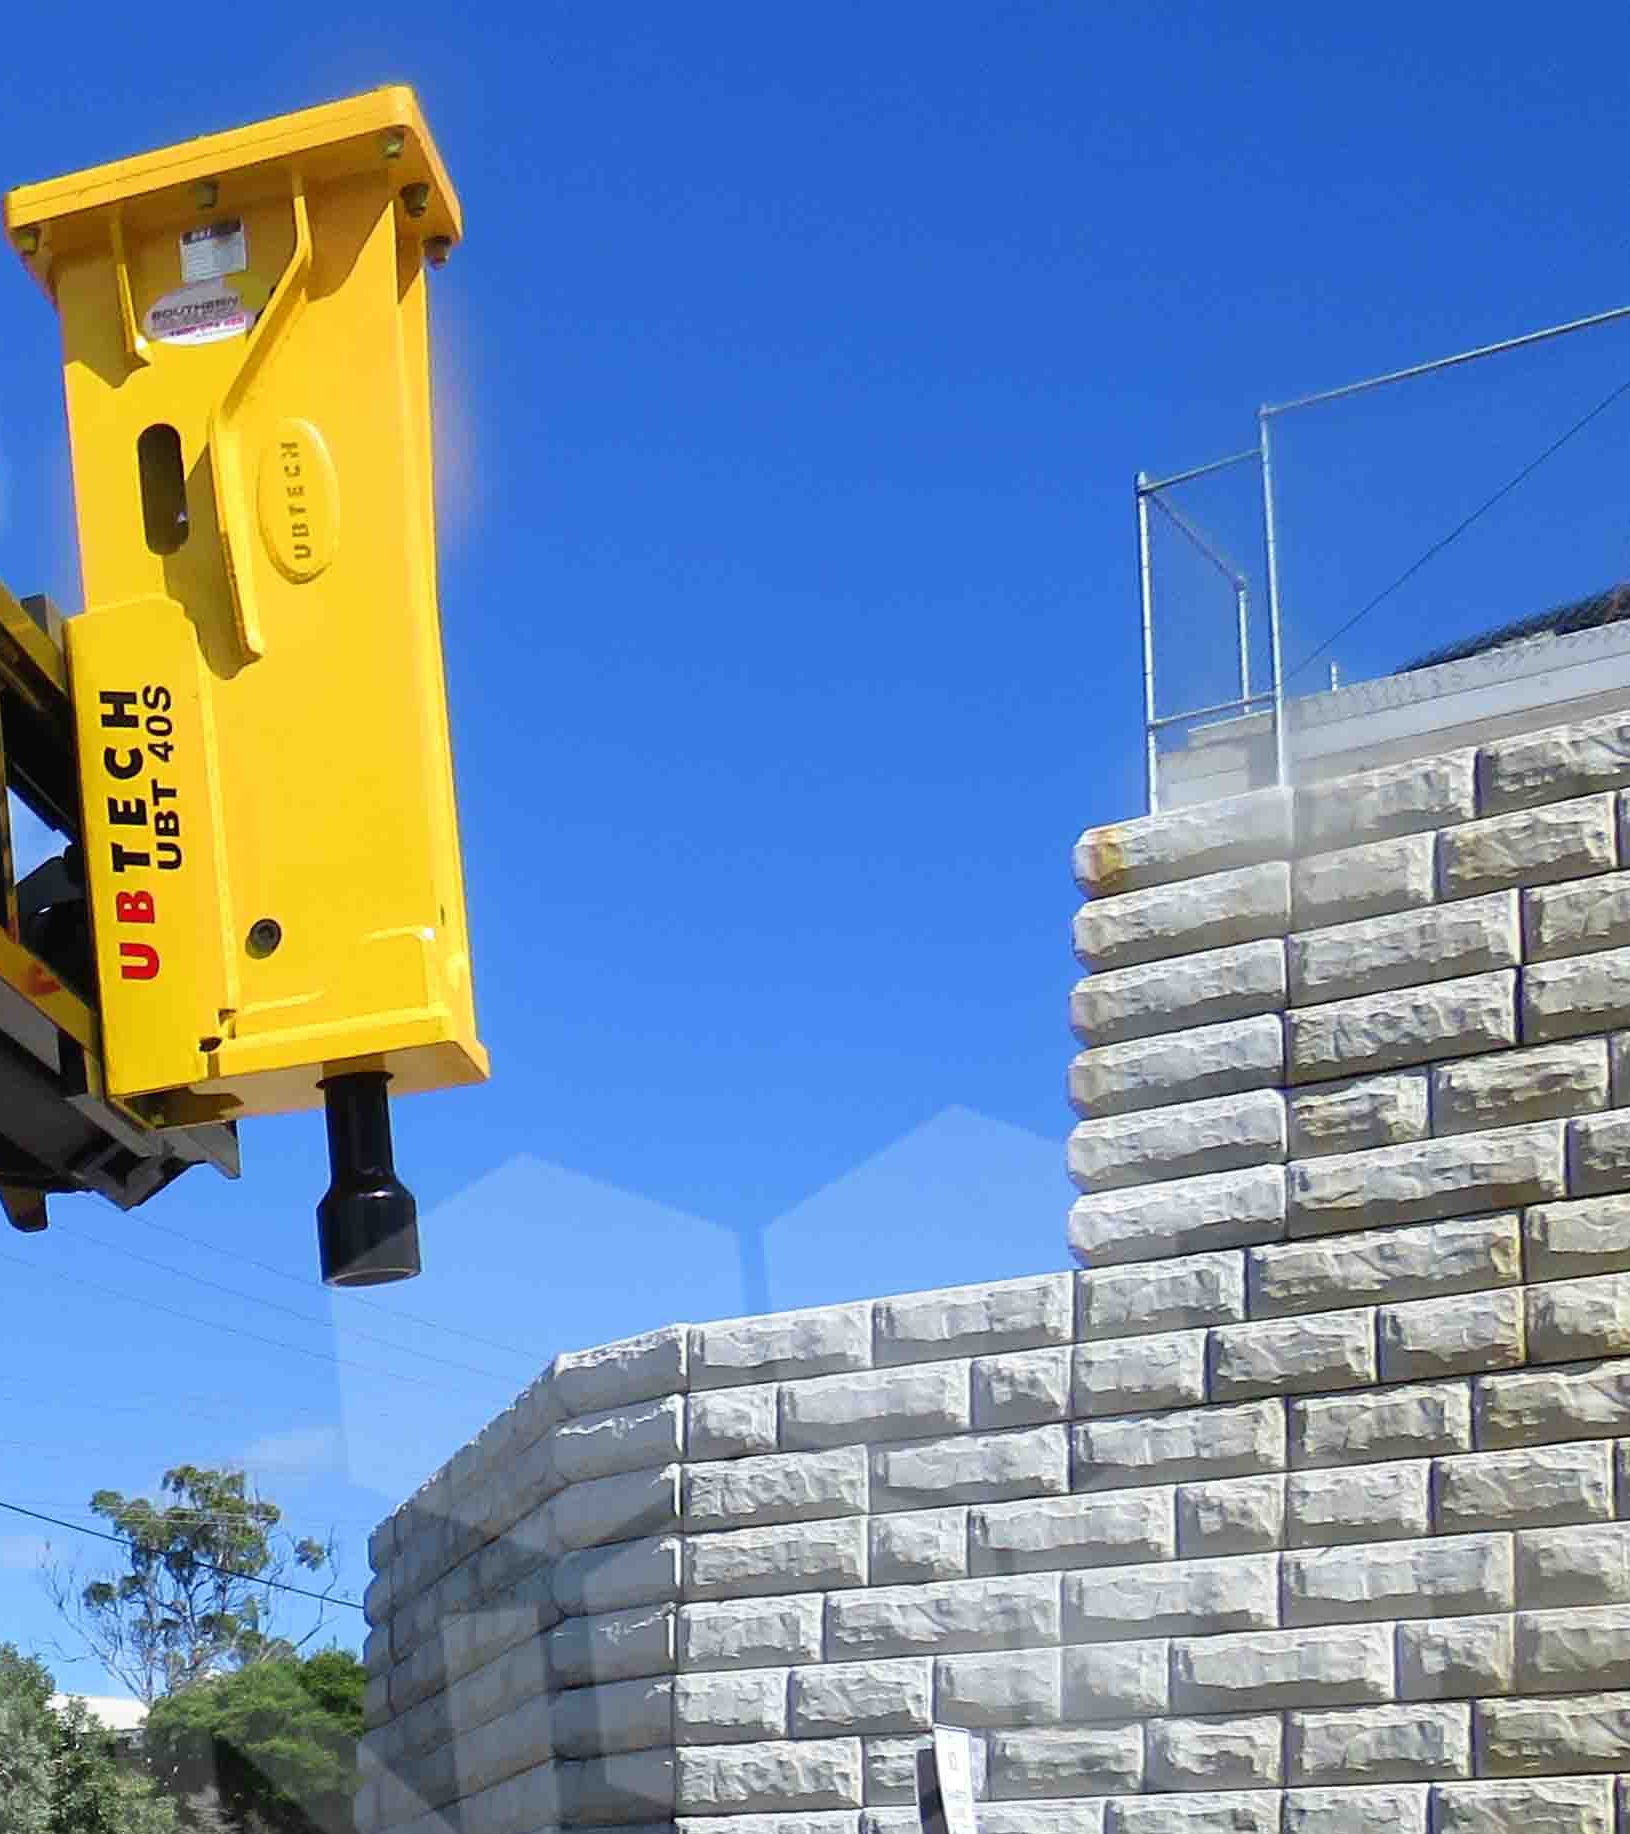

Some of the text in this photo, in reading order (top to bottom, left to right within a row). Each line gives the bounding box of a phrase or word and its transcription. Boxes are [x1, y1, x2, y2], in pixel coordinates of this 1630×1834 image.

[279, 441, 312, 560] UBTECH
[99, 690, 161, 981] UBTECH
[142, 684, 183, 871] UBT 40S
